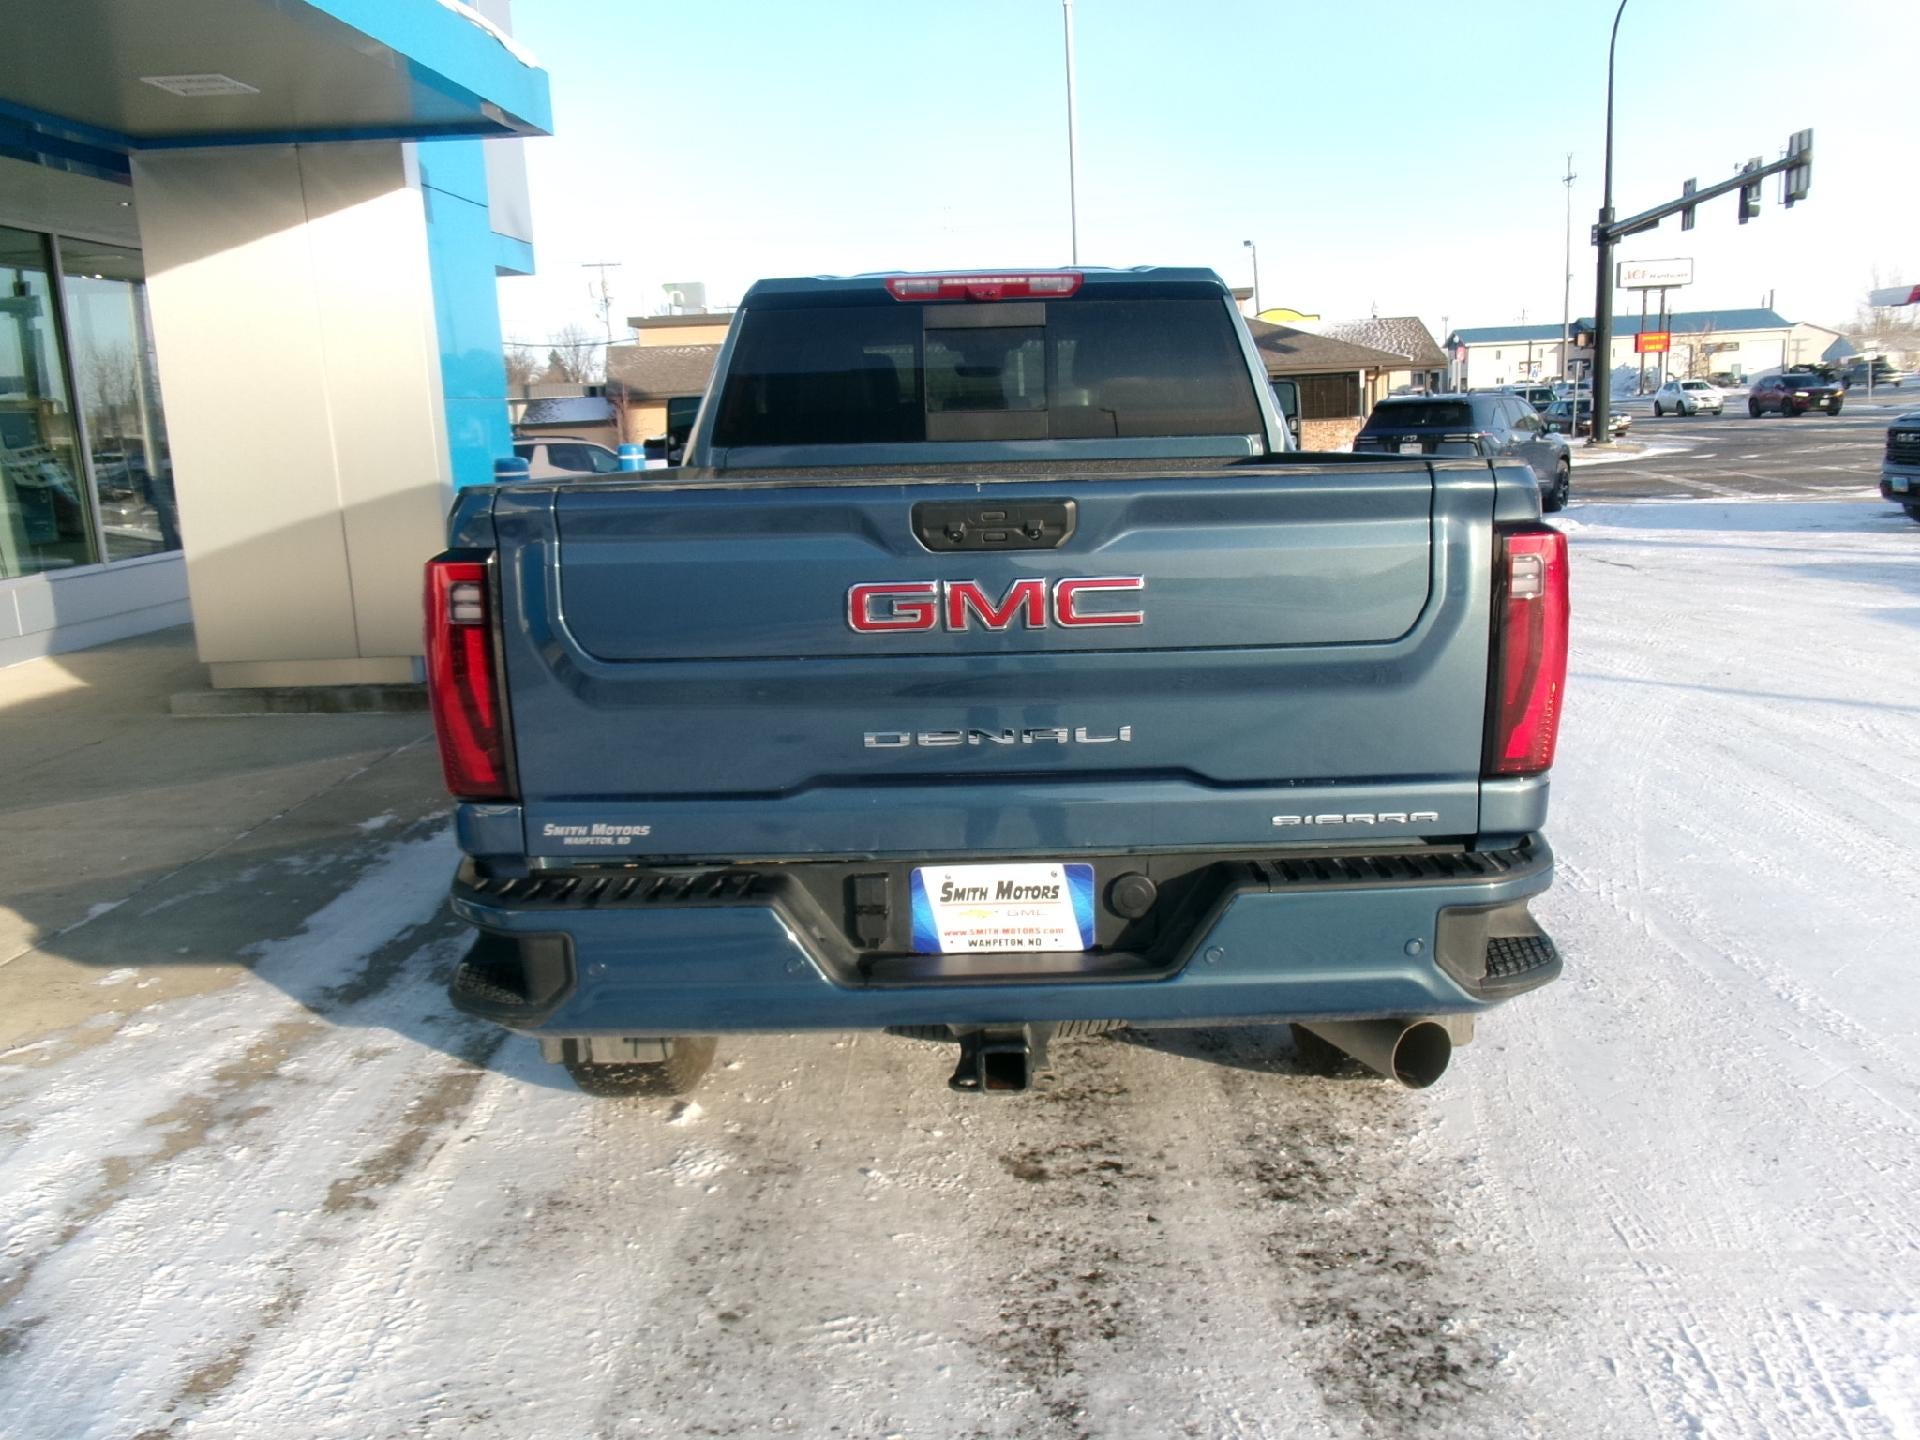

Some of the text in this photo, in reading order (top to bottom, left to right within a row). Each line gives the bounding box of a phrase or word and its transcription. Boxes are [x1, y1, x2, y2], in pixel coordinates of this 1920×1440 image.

[847, 574, 1145, 633] GMC
[863, 725, 1132, 748] DENALI
[543, 823, 651, 836] SMITH MOTORS
[1271, 811, 1439, 826] SIERRA
[940, 880, 1060, 902] SMITH MOTORS
